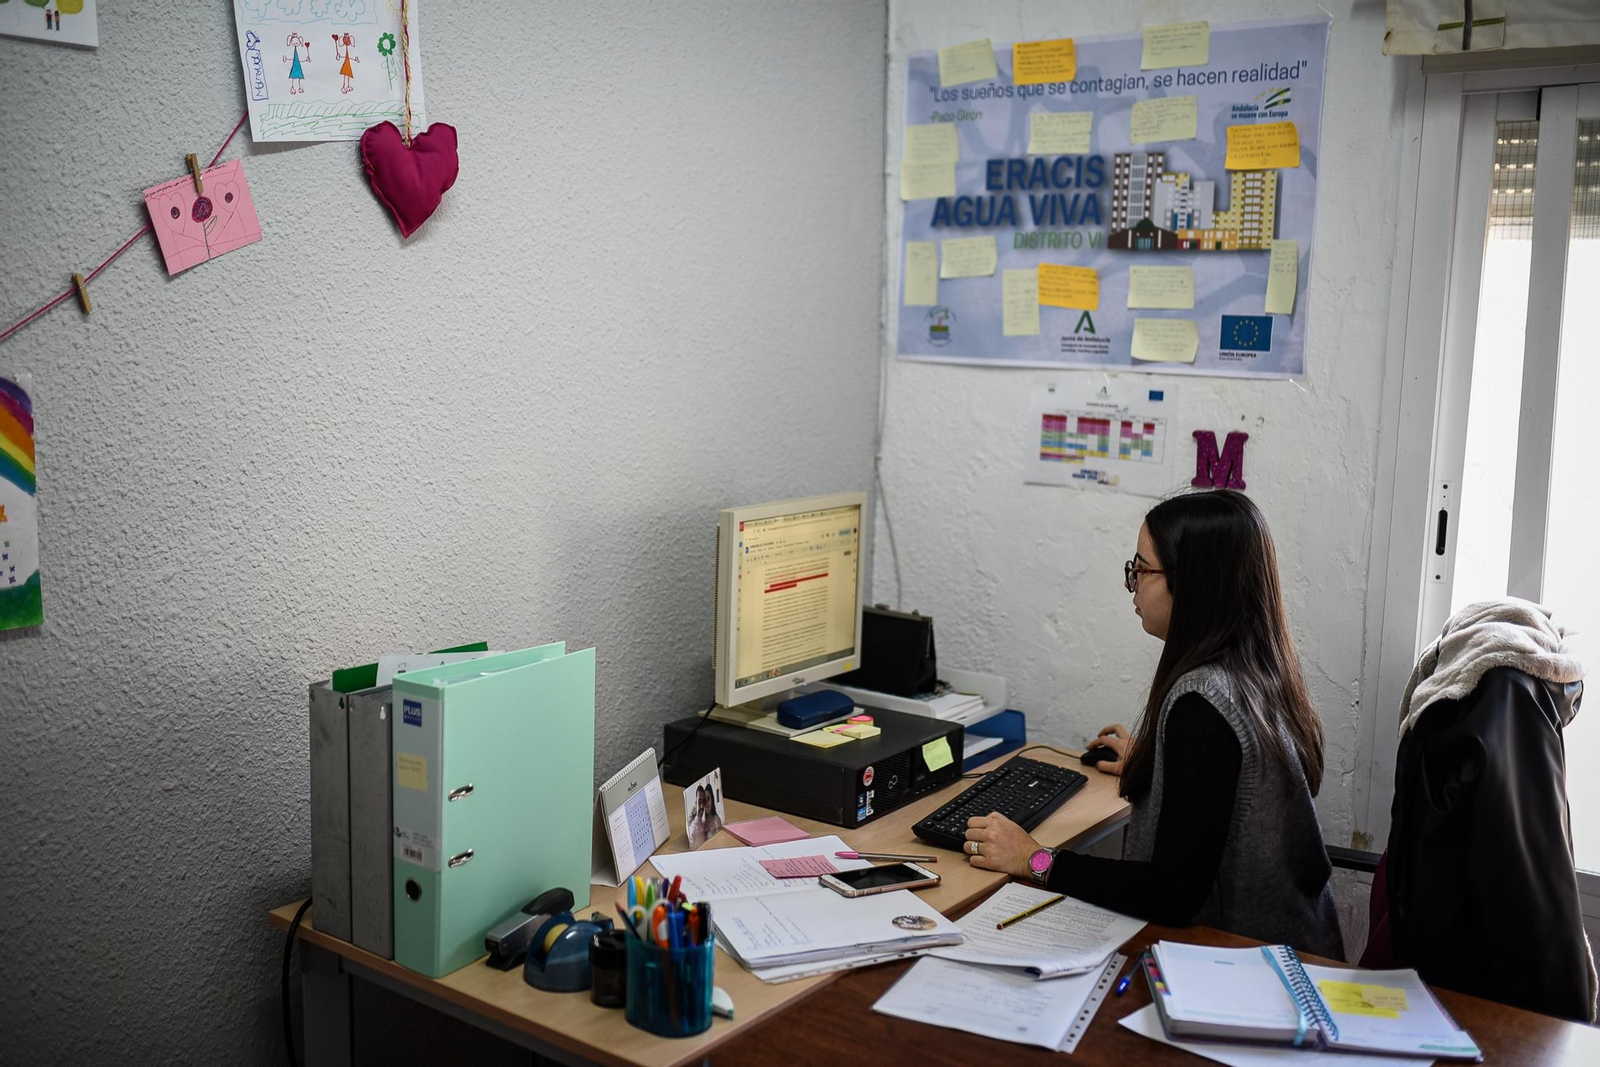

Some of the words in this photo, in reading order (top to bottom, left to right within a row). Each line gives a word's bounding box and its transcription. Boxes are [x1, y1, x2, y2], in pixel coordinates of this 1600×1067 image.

[929, 86, 958, 102] "Los
[961, 82, 1014, 99] sueños
[1017, 84, 1045, 100] que
[1049, 82, 1067, 95] se
[1069, 73, 1149, 95] contagian,
[1153, 75, 1173, 88] se
[1176, 68, 1227, 87] hacen
[1231, 60, 1308, 84] realidad"
[1269, 110, 1288, 118] Europa
[985, 155, 1106, 191] ERACIS
[930, 195, 1017, 228] AGUA
[1028, 193, 1102, 226] VIVA
[1013, 231, 1083, 249] DISTRITO
[1088, 231, 1103, 249] VI
[1191, 430, 1249, 490] M
[403, 705, 421, 717] PLUS
